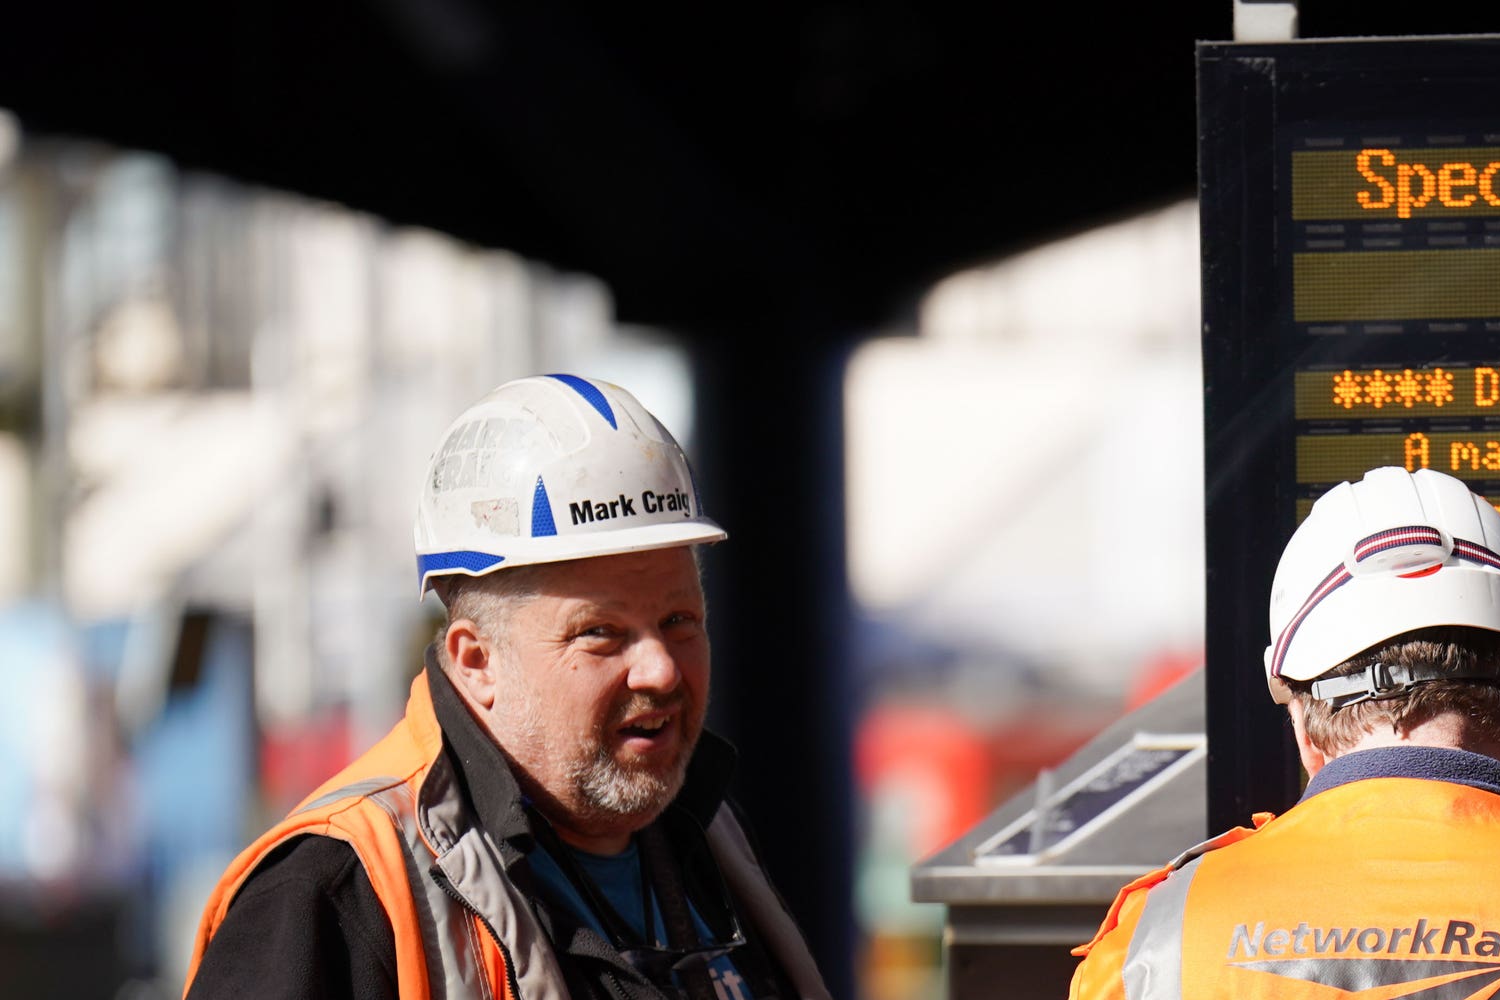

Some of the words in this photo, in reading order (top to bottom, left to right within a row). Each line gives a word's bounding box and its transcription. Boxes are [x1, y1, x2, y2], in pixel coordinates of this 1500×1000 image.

[1404, 432, 1430, 472] A
[569, 494, 637, 526] Mark
[641, 488, 691, 518] Craig
